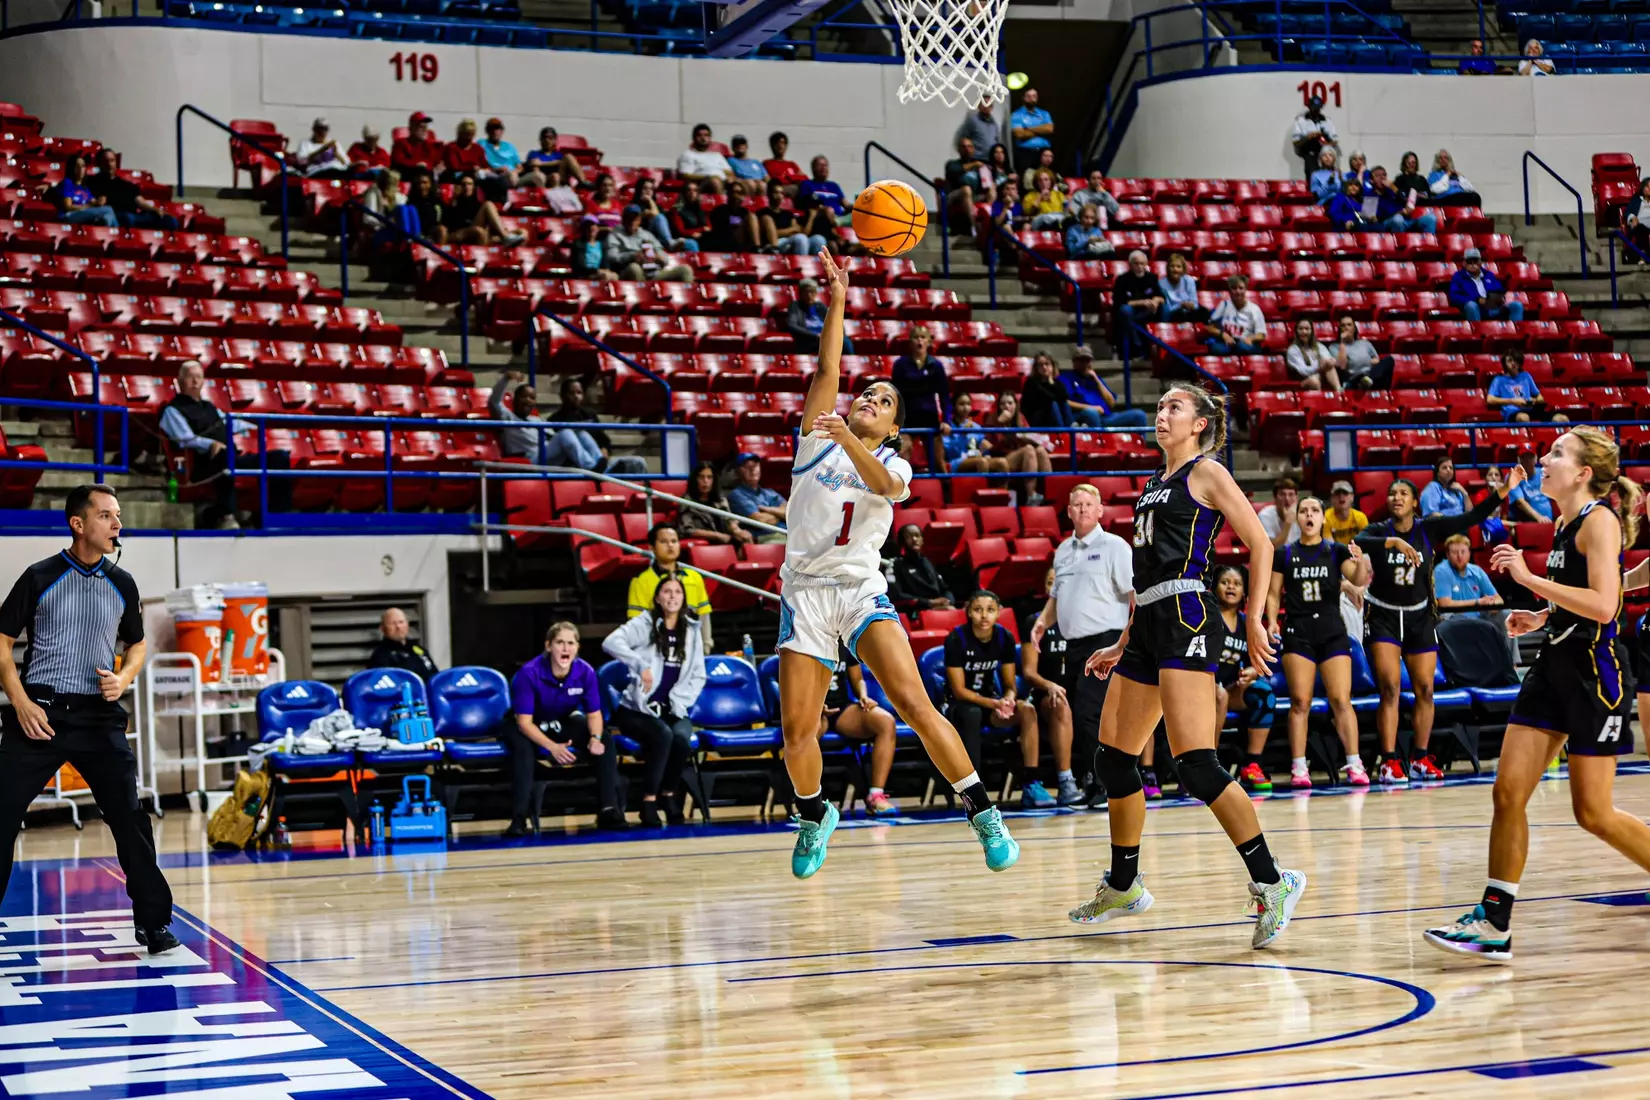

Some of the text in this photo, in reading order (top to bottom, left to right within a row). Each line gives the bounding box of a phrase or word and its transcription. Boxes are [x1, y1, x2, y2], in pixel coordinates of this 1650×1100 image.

[388, 51, 439, 83] 119
[1297, 80, 1342, 108] 101
[834, 501, 855, 546] 1
[1387, 551, 1424, 565] LSA
[1293, 565, 1329, 579] LSUA
[1394, 566, 1416, 586] 24
[1301, 580, 1322, 602] 21
[1224, 635, 1248, 652] SUA
[965, 660, 999, 672] LSUA
[972, 673, 985, 690] 5
